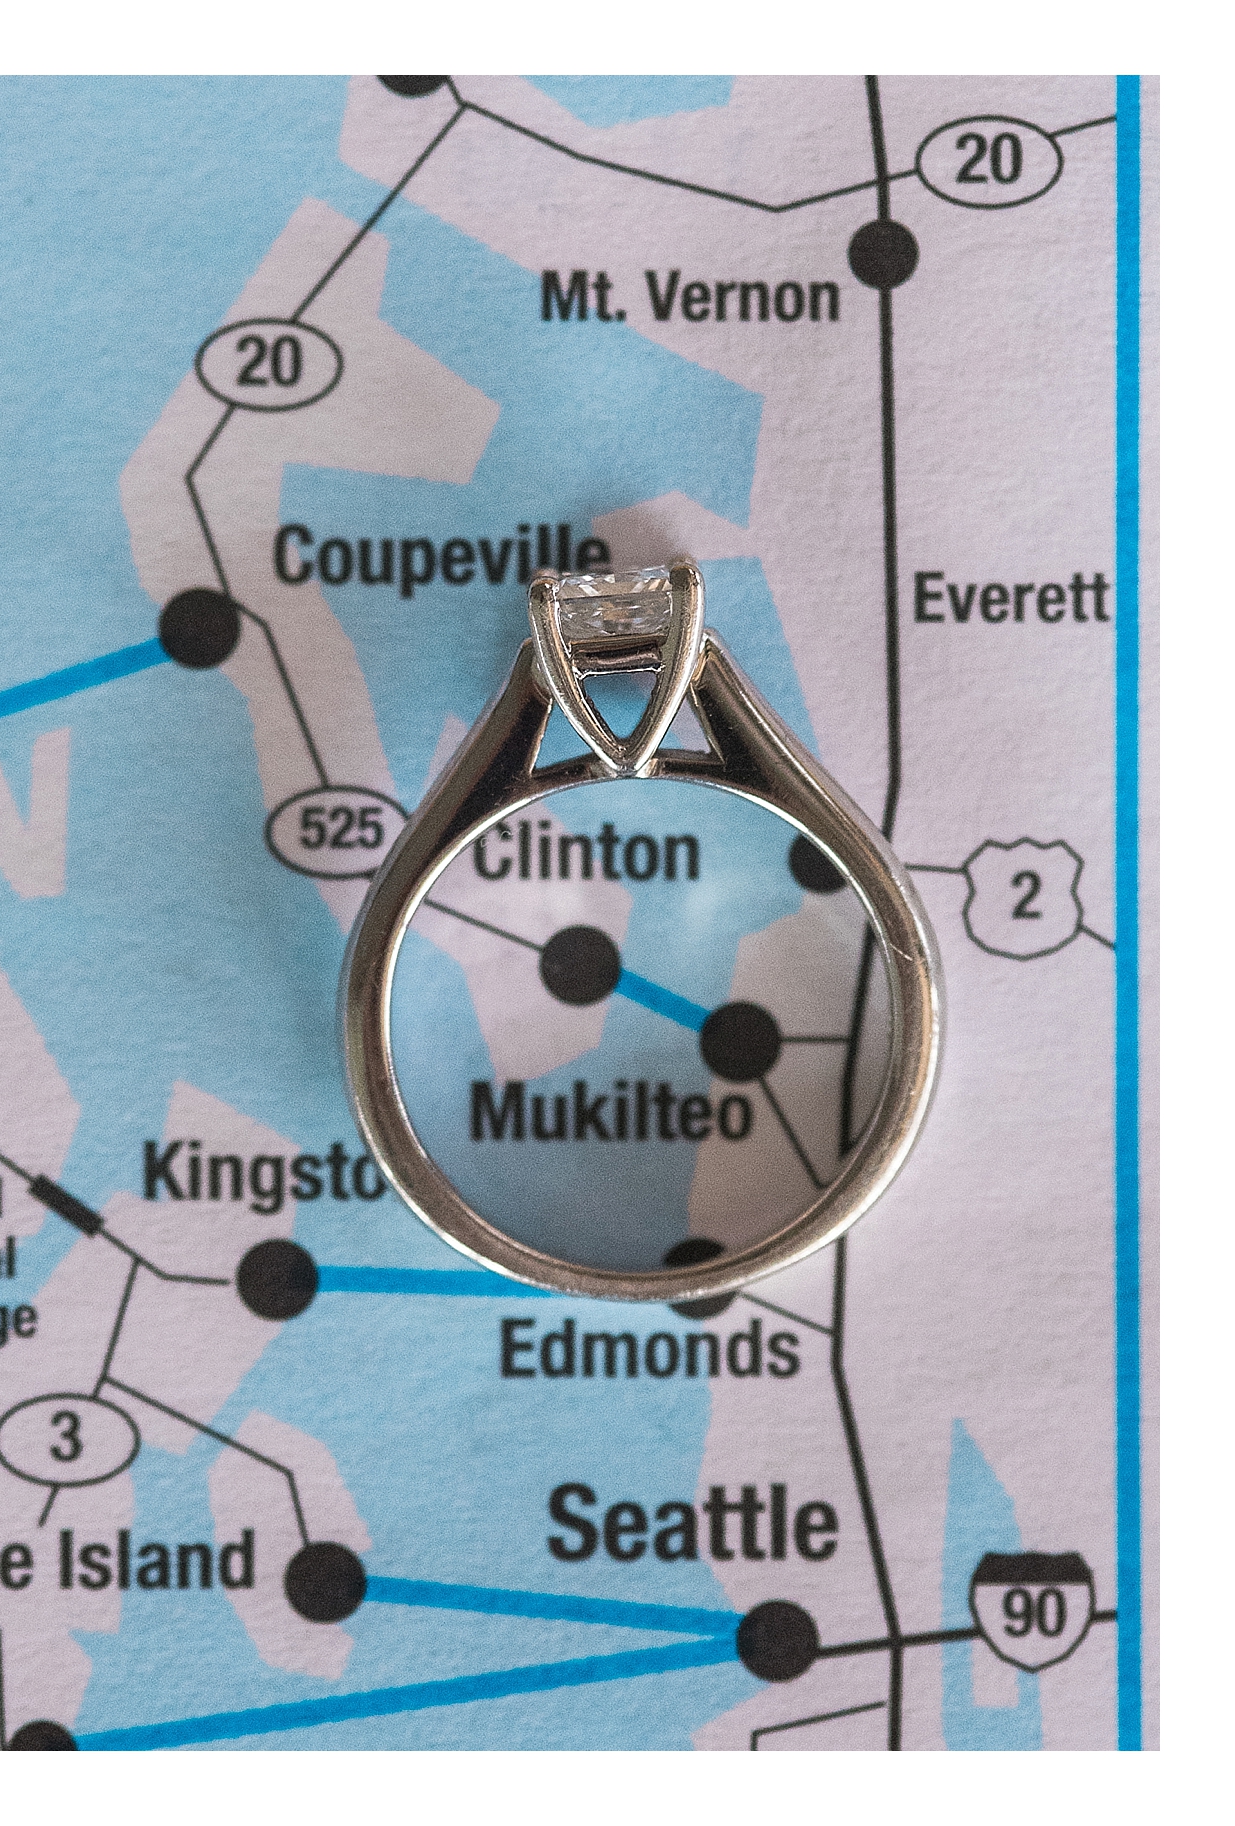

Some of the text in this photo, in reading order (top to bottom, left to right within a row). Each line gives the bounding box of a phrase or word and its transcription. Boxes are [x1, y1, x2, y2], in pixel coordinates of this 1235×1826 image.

[955, 132, 1023, 186] 20
[541, 270, 841, 323] Mt. Vernon
[235, 335, 303, 388] 20
[273, 522, 612, 599] Coupeville
[913, 570, 1111, 624] Everett
[299, 807, 385, 851] 525
[473, 821, 701, 882] Clinton
[1012, 870, 1042, 920] 2
[469, 1079, 753, 1144] Mukilteo
[144, 1139, 387, 1216] Kingsto
[500, 1316, 802, 1380] Edmonds
[49, 1410, 83, 1463] 3
[547, 1481, 840, 1564] Seattle
[59, 1527, 255, 1591] Island
[1002, 1588, 1067, 1638] 90
